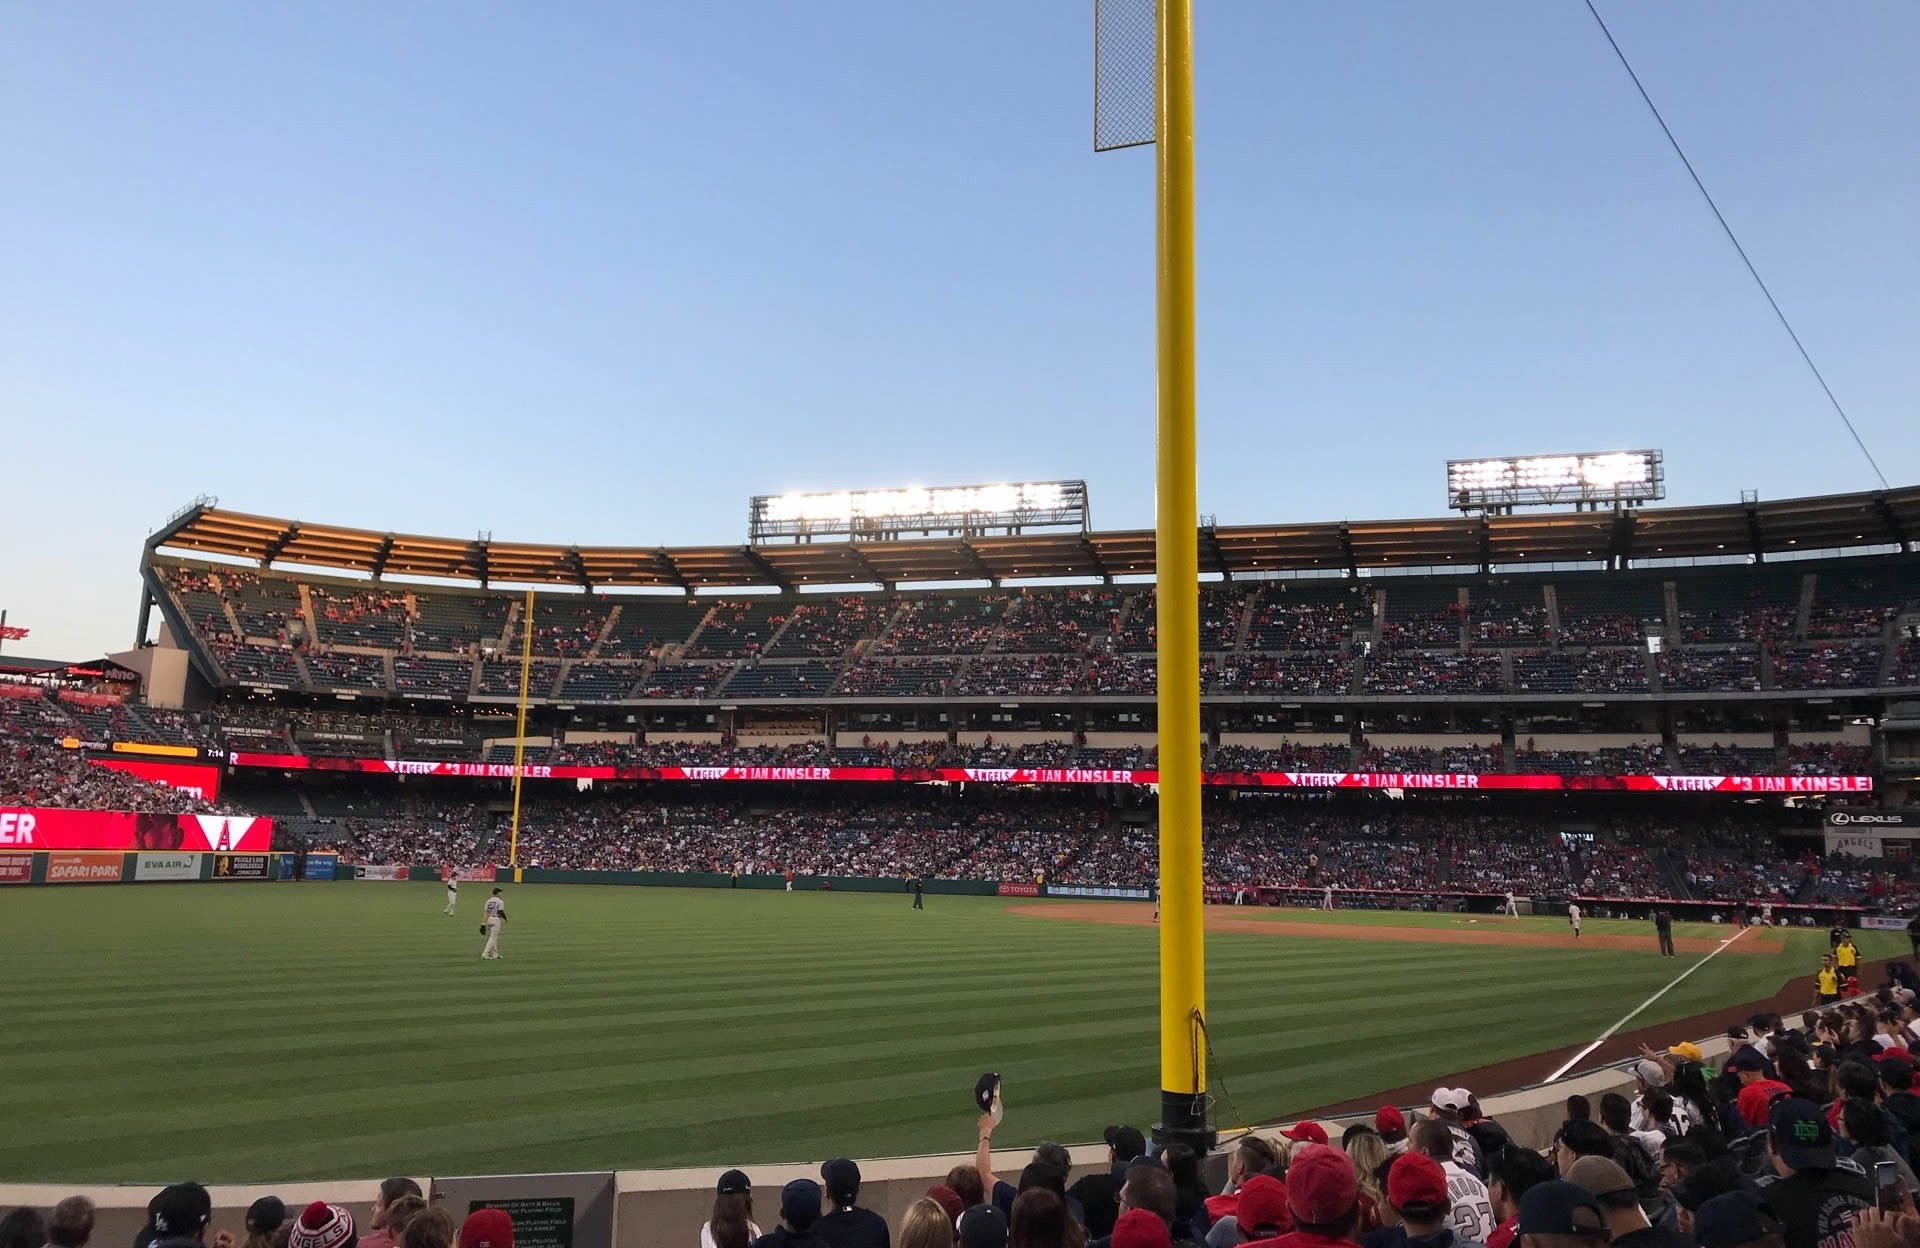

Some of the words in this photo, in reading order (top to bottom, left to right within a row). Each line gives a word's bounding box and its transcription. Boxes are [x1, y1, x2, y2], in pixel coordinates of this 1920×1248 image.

[207, 749, 224, 757] 7:14
[445, 763, 460, 775] #3
[465, 764, 484, 776] IAN
[733, 767, 747, 779] #3
[751, 767, 769, 779] IAN
[772, 768, 831, 780] KINSLER
[1023, 769, 1037, 781] #3
[1042, 769, 1061, 782] IAN
[1066, 770, 1132, 782] KINSLER
[1353, 774, 1370, 786] #3
[1375, 774, 1398, 787] IAN
[1402, 775, 1479, 787] KINSLER
[1732, 776, 1753, 790] #3
[1759, 777, 1785, 790] IAN
[1791, 777, 1872, 791] KINSLE
[1850, 815, 1902, 823] LEXUS
[51, 866, 89, 877] SAFARI
[91, 865, 118, 877] PARK
[1010, 886, 1038, 894] TOYOTA
[1454, 1202, 1496, 1240] 27
